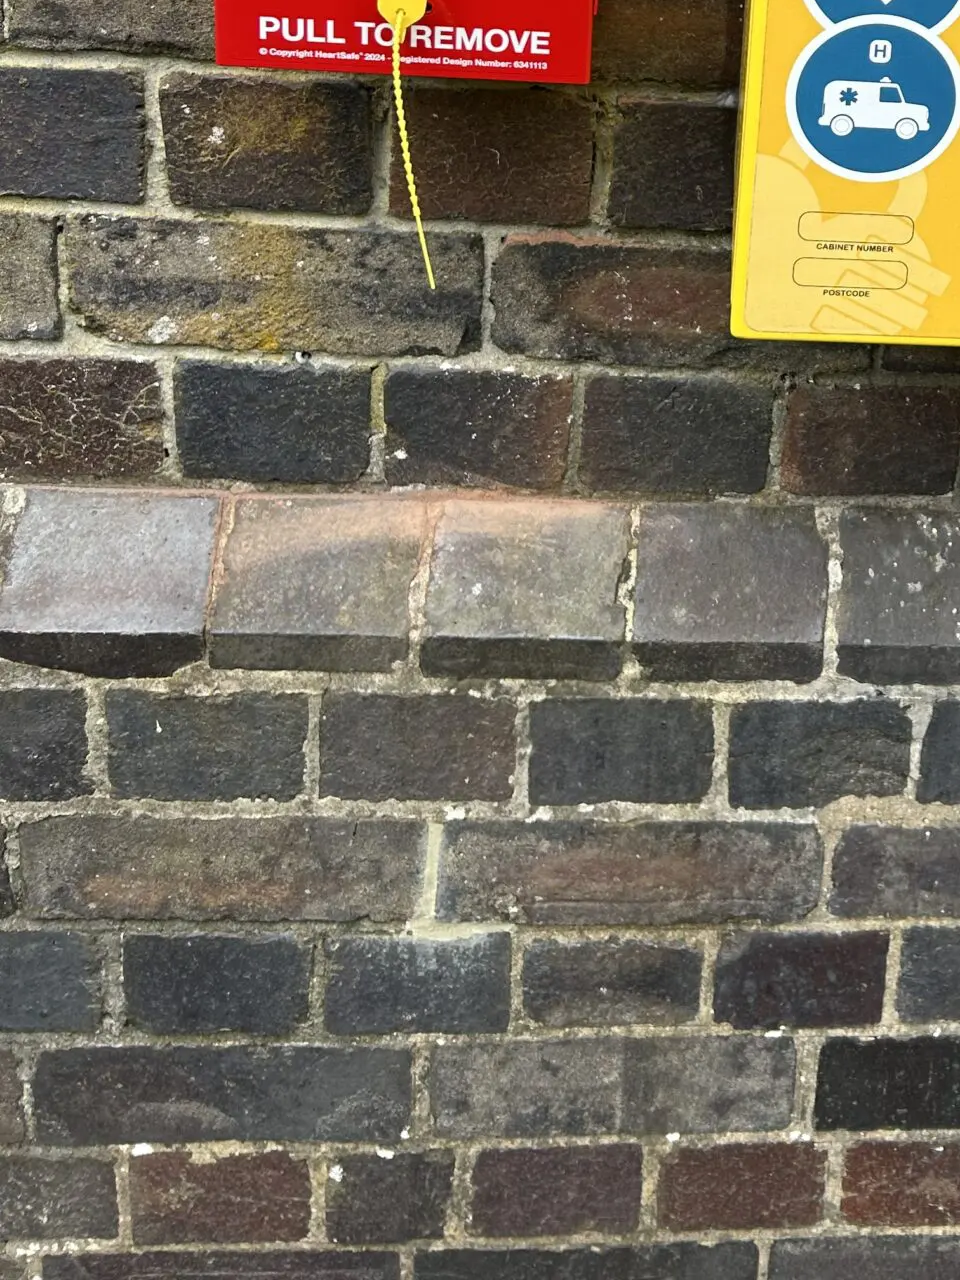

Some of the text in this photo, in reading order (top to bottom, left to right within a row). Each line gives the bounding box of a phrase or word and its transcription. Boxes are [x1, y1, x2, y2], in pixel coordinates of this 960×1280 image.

[260, 16, 550, 55] PULL TO REMOVE
[269, 48, 313, 58] Copyright
[364, 53, 385, 61] 2024
[401, 56, 440, 64] egistered
[443, 57, 473, 66] Design
[475, 59, 511, 67] Number:
[874, 41, 887, 59] H
[816, 243, 894, 253] CABINET NUMBER
[822, 289, 870, 297] POSTCODE
